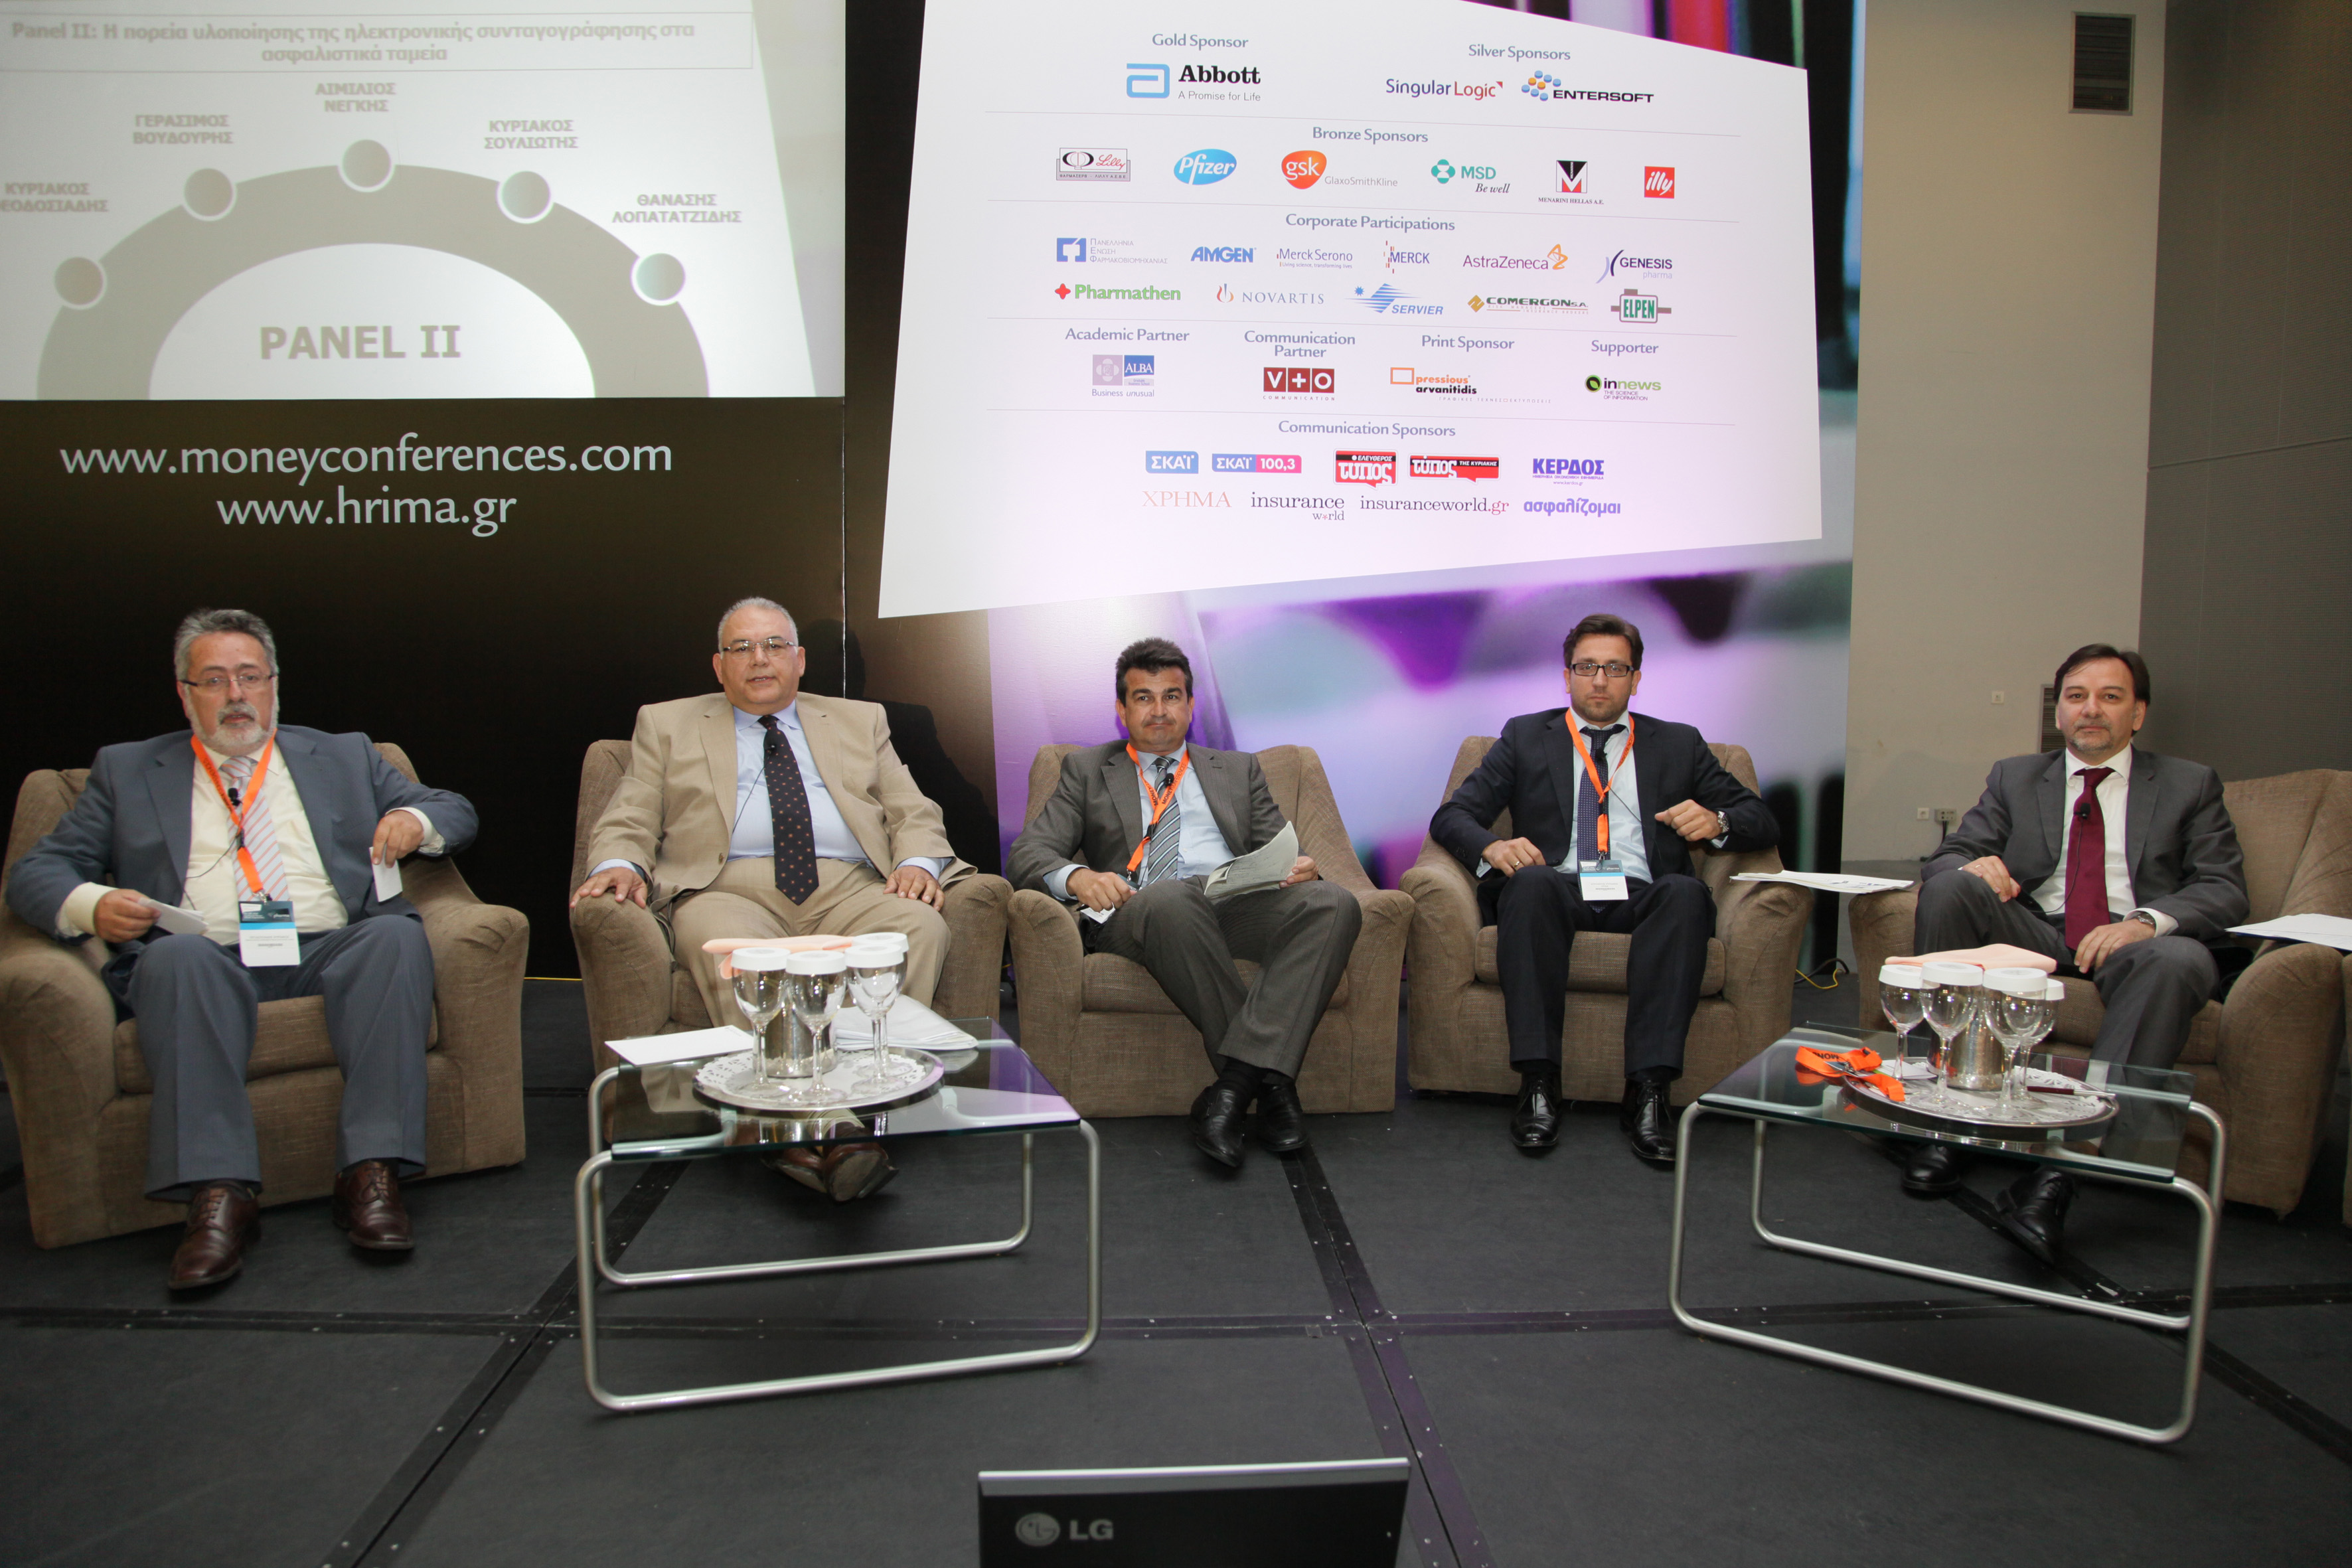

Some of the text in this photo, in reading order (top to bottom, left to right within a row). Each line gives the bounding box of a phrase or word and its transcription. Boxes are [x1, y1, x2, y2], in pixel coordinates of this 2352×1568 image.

[12, 22, 67, 39] Panel
[71, 23, 98, 39] II:
[124, 23, 188, 40] πορεία
[308, 26, 340, 42] της
[661, 24, 694, 37] στα
[1152, 33, 1249, 50] Gold Sponsor
[262, 44, 447, 64] ασφαλιστικά ταμεία
[1468, 44, 1571, 62] Silver Sponsors
[1178, 65, 1261, 84] Abbott
[315, 82, 396, 96] ΑΙΜΙΛΙΟΣ
[1189, 91, 1225, 100] Promise
[1228, 92, 1241, 100] for
[1243, 92, 1261, 101] Life
[1553, 90, 1654, 103] ENTERSOFT
[324, 100, 388, 113] ΝΕΓΚΗΣ
[135, 114, 229, 128] ΓΕΡΑΣΙΜΟΣ
[489, 119, 574, 133] ΚΥΡΙΑΚΟΣ
[133, 131, 233, 145] ΒΟΥΔΟΥΡΗΣ
[484, 136, 578, 149] ΣΟΥΛΙΩΤΗΣ
[1312, 126, 1429, 145] Bronze Sponsors
[1096, 154, 1126, 170] Lilly
[1286, 155, 1320, 181] gsk
[1179, 154, 1235, 185] Pfizer
[1461, 166, 1496, 180] MSD
[5, 182, 90, 195] ΚΥΡΙΑΚΟΣ
[1324, 176, 1398, 187] GlaxoSmithKline
[1475, 183, 1510, 194] Be well
[1646, 171, 1673, 196] illy
[637, 194, 717, 207] ΘΑΝΑΣΗΣ
[611, 210, 742, 224] ΛΟΠΑΤΑΤΖΙΔΗΣ
[1285, 214, 1455, 233] Corporate Participations
[1191, 246, 1253, 263] AMGEN
[1279, 248, 1353, 261] Merck Serono
[1390, 252, 1429, 264] MERCK
[1462, 255, 1549, 270] AstraZeneca
[1620, 257, 1672, 270] GENESIS
[1642, 270, 1672, 279] pharma
[1075, 284, 1181, 301] Pharmathen
[1242, 291, 1324, 304] NOVARTIS
[1486, 297, 1571, 307] COMERGON
[1624, 299, 1654, 319] ELPEN
[1392, 304, 1443, 315] SERVIER
[1065, 327, 1190, 342] Academic Partner
[1244, 331, 1355, 345] Communication
[260, 325, 461, 360] PANEL II
[1421, 335, 1514, 352] Print Sponsor
[1591, 340, 1658, 356] Supporter
[1274, 345, 1326, 358] Partner
[1125, 363, 1154, 373] ALBA
[1416, 374, 1468, 385] pressious
[1604, 378, 1662, 390] innews
[1092, 388, 1123, 397] Business
[1415, 385, 1477, 394] arvanitidis
[1278, 420, 1456, 439] Communication Sponsors
[60, 432, 672, 486] www.moneyconferences.com
[1261, 458, 1296, 471] 100,3
[1533, 458, 1605, 475] ΚΕΡΔΟΣ
[1142, 491, 1232, 508] ΧΡΗΜΑ
[1251, 491, 1345, 509] insurance
[1360, 496, 1509, 515] insuranceworld.gr
[217, 485, 517, 536] www.hrima.gr
[1524, 497, 1620, 518] ασφαλίζομαι
[1070, 1519, 1113, 1541] LG
